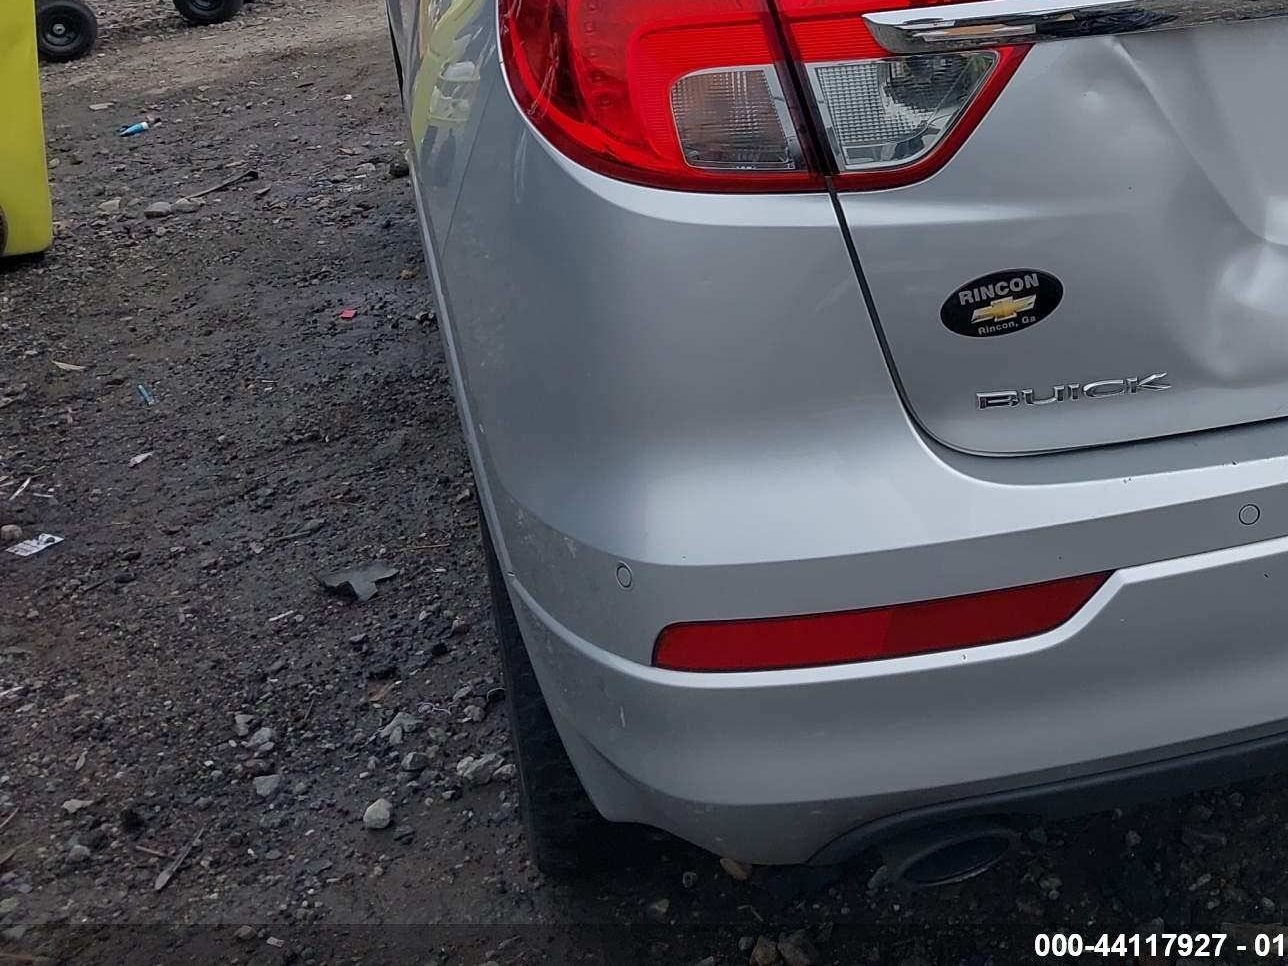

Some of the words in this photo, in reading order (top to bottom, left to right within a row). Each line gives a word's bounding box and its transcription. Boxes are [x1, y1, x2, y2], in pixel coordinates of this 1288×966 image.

[958, 273, 1040, 306] RINCON
[977, 320, 1019, 336] Rincon,
[1021, 315, 1037, 325] Ga
[975, 371, 1172, 411] BUICK
